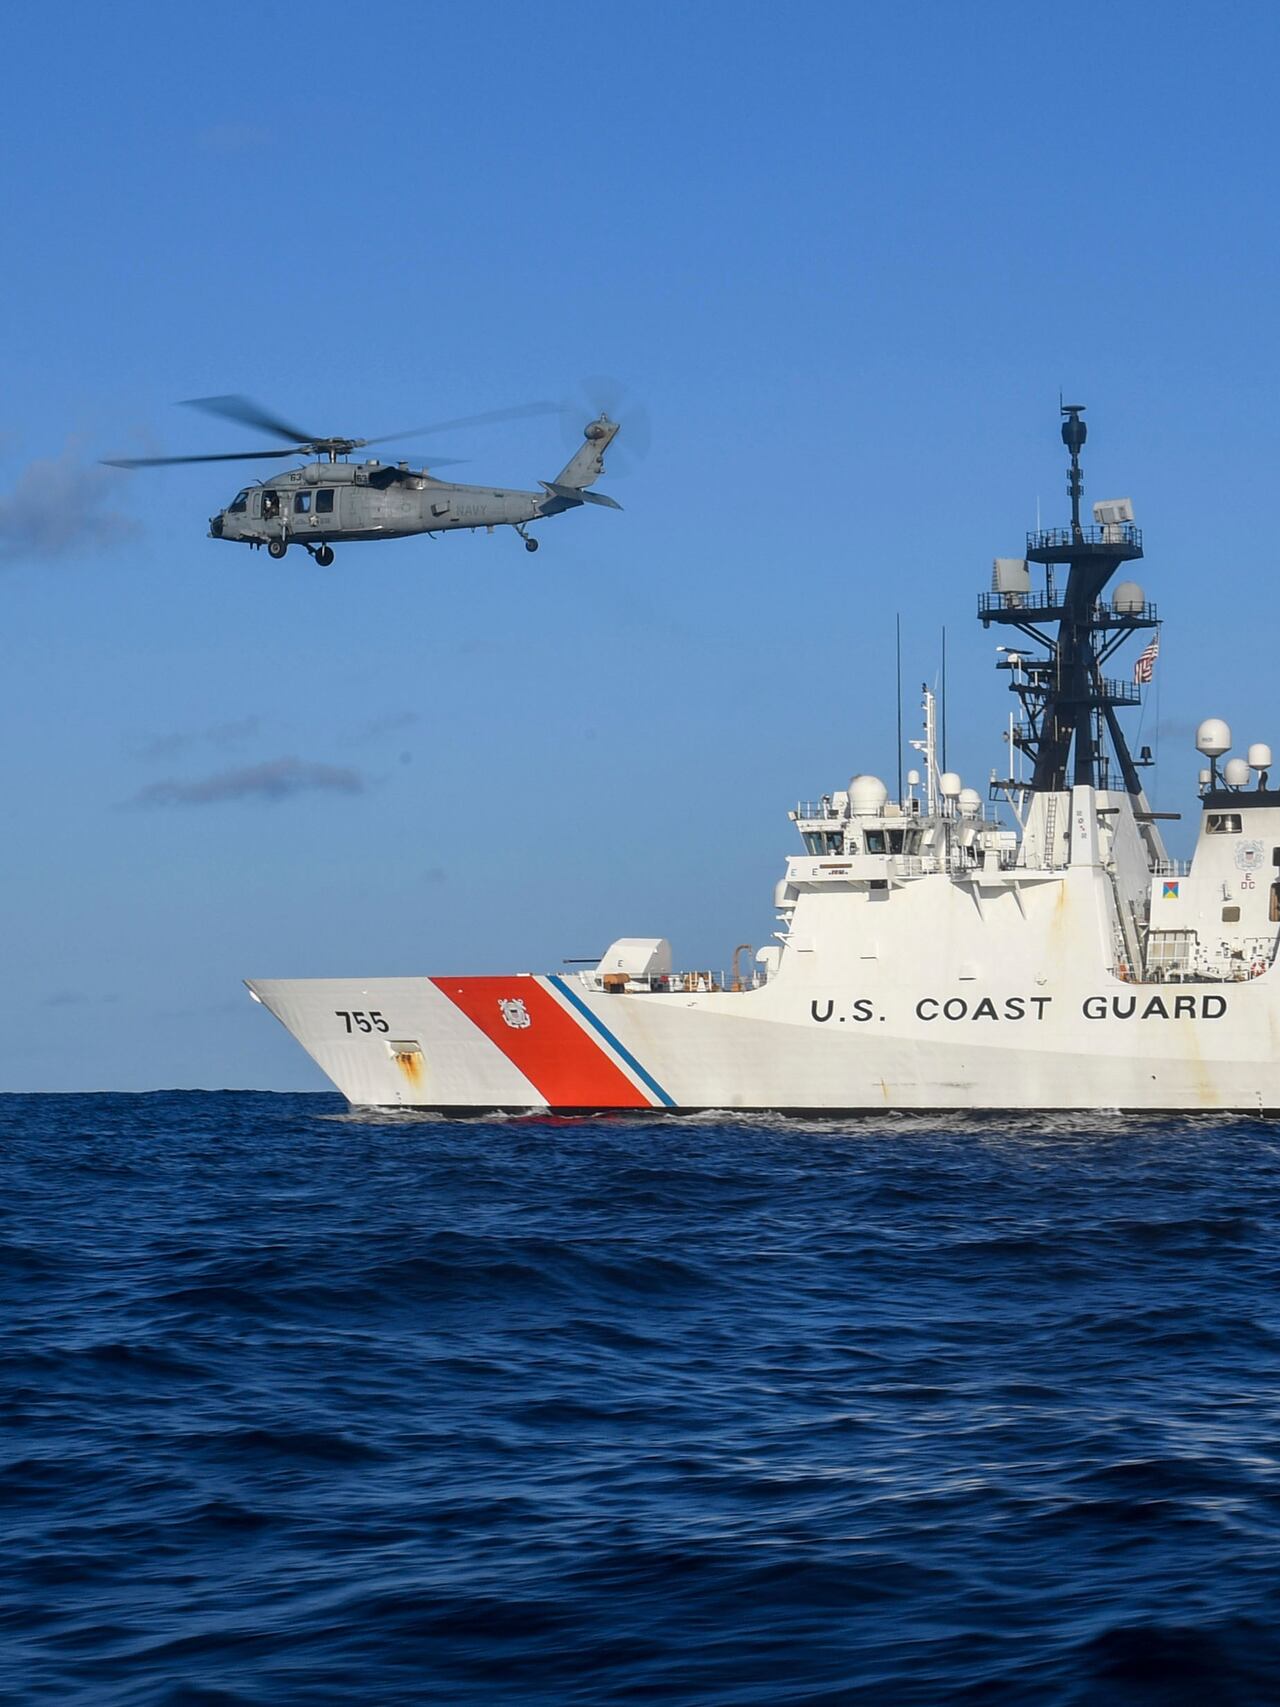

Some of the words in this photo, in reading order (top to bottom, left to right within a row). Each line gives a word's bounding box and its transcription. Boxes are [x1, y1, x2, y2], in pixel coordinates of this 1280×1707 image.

[456, 504, 488, 516] NAVY
[811, 1000, 886, 1022] U.S.
[915, 997, 1052, 1021] COAST
[1082, 995, 1227, 1020] GUARD
[335, 1011, 390, 1033] 755
